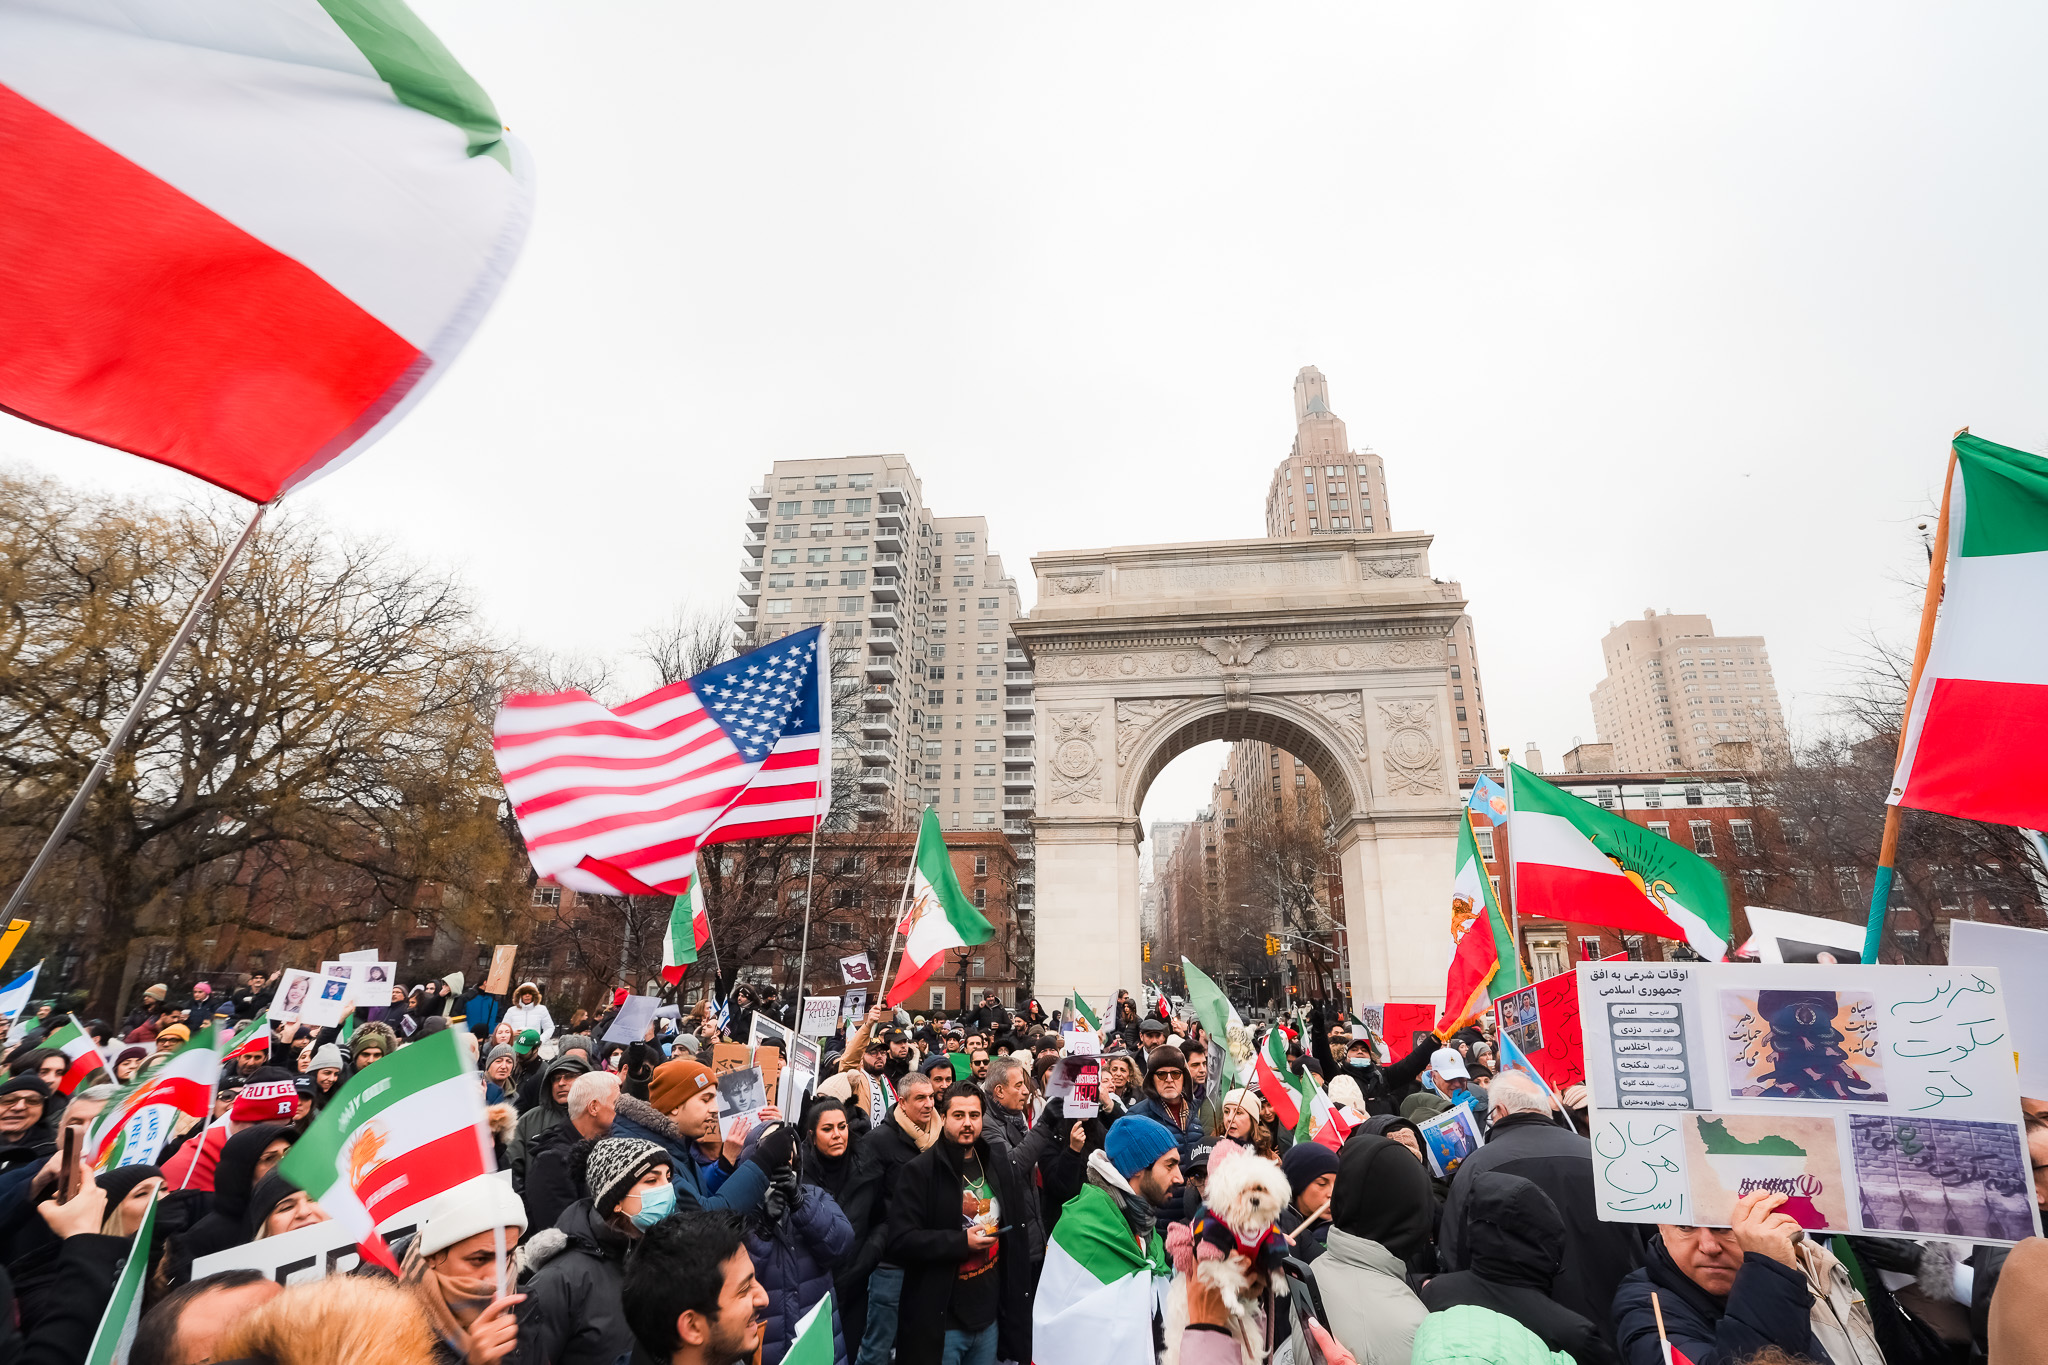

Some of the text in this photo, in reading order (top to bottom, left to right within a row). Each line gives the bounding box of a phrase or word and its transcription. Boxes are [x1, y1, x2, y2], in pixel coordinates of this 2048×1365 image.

[1168, 574, 1204, 582] HONEST
[1210, 572, 1230, 580] CAN
[1234, 571, 1266, 579] REPAIR
[1282, 569, 1298, 577] THE
[1304, 567, 1336, 576] EVENT
[1170, 581, 1196, 590] HAND
[1274, 575, 1337, 584] WASHINGTON
[1590, 969, 1688, 981] اوقات شرعی به افق
[1600, 985, 1682, 996] جمهوری اسلامی
[1618, 1008, 1637, 1016] اعدام
[1851, 1002, 1872, 1018] سپاه
[1736, 1014, 1756, 1028] رهبر
[1728, 1029, 1761, 1043] حمایت
[1619, 1043, 1650, 1052] اختلاس
[1621, 1061, 1650, 1070] شکنجه
[1074, 1086, 1097, 1102] HELP!
[277, 1101, 292, 1114] R
